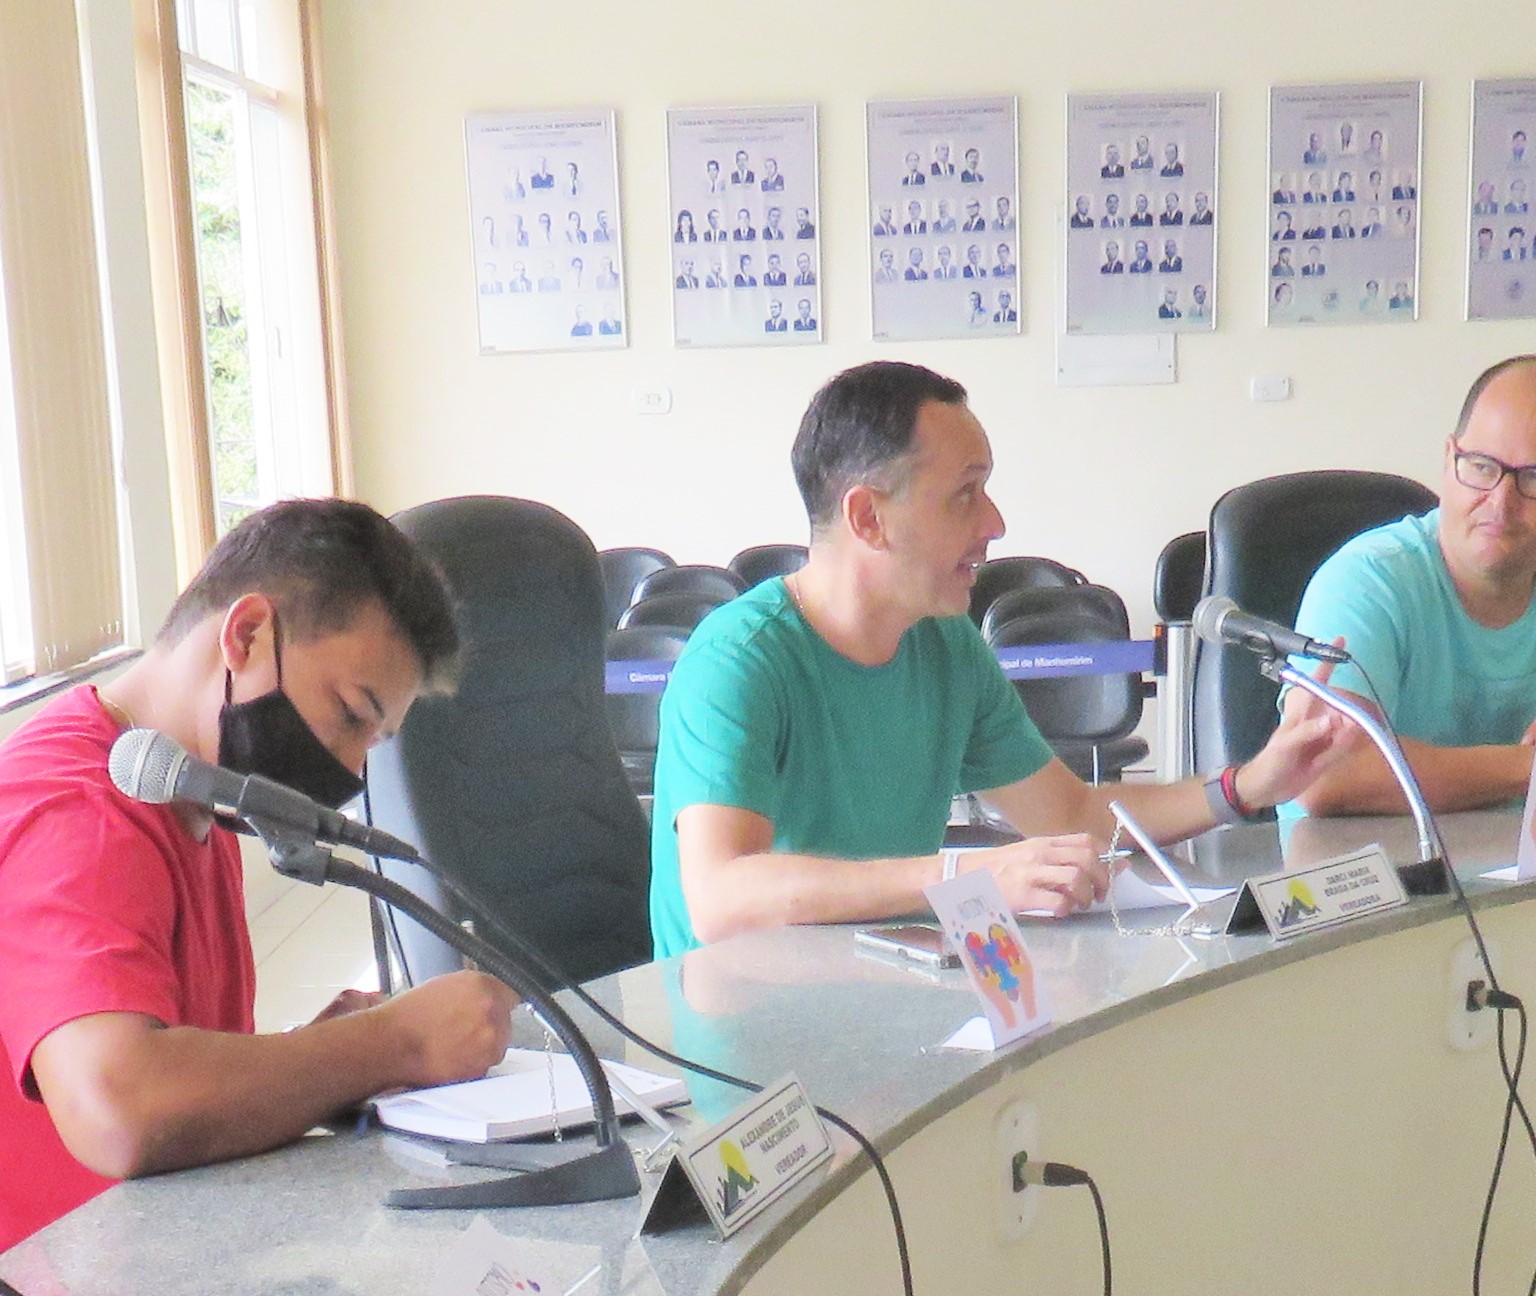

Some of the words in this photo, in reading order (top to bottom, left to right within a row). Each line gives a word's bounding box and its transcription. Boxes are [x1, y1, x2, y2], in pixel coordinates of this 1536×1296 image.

[629, 672, 666, 683] Câmara
[1020, 659, 1033, 668] de
[739, 1115, 777, 1150] ALEXANDRE
[774, 1108, 785, 1123] DE
[758, 1117, 801, 1154] NASCIMENTO
[774, 1143, 809, 1175] VEREADOR
